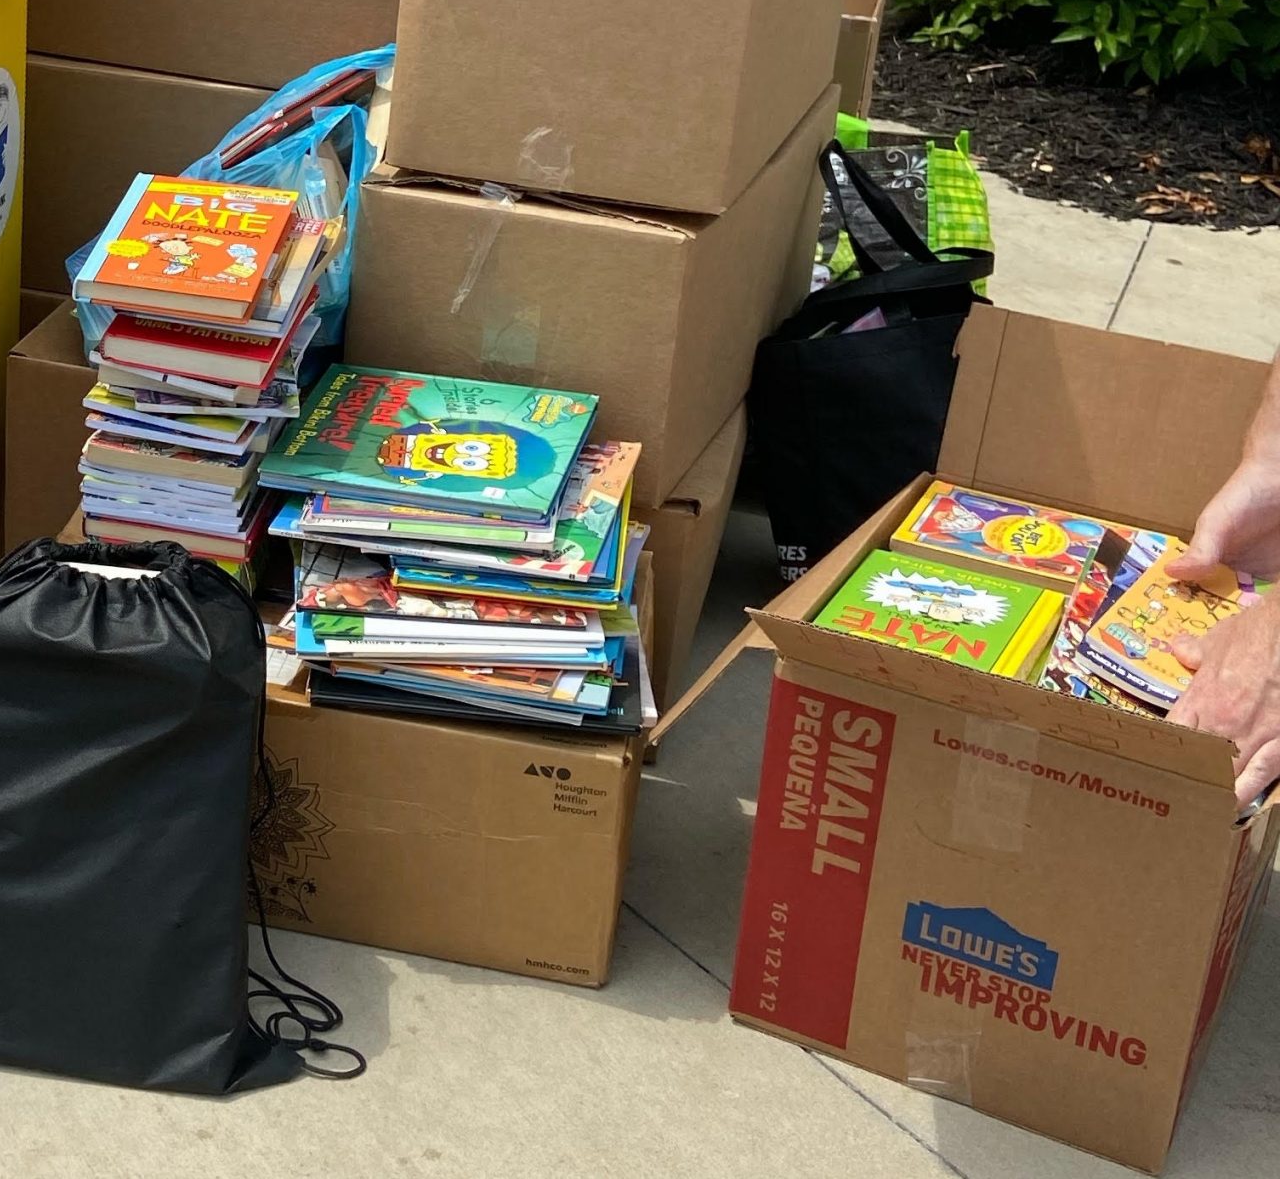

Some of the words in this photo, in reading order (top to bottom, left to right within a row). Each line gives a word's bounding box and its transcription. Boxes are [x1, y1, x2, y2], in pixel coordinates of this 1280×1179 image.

[174, 195, 257, 213] BIG
[144, 202, 274, 234] NATE
[142, 220, 262, 240] DOODLEPALOOZA
[330, 373, 357, 390] Tales
[318, 391, 341, 408] from
[461, 386, 484, 415] Stories
[304, 408, 332, 430] Bikini
[284, 429, 318, 457] Bottom
[832, 605, 988, 661] NATE
[778, 696, 825, 832] PEQUEÑA
[931, 728, 1172, 819] Lowes.com/Moving
[554, 793, 588, 805] Mifflin
[555, 781, 608, 797] Houghton
[811, 710, 884, 877] SMALL
[553, 803, 598, 817] Harcourt
[771, 902, 789, 924] 16
[768, 925, 786, 942] X
[919, 914, 1041, 979] LOWE'S
[525, 957, 590, 976] hmhco.com
[765, 948, 782, 969] 12
[763, 971, 779, 987] X
[900, 944, 983, 987] NEVER
[986, 973, 1053, 1007] STOP
[760, 992, 777, 1012] 12
[920, 962, 1149, 1068] IMPROVING
